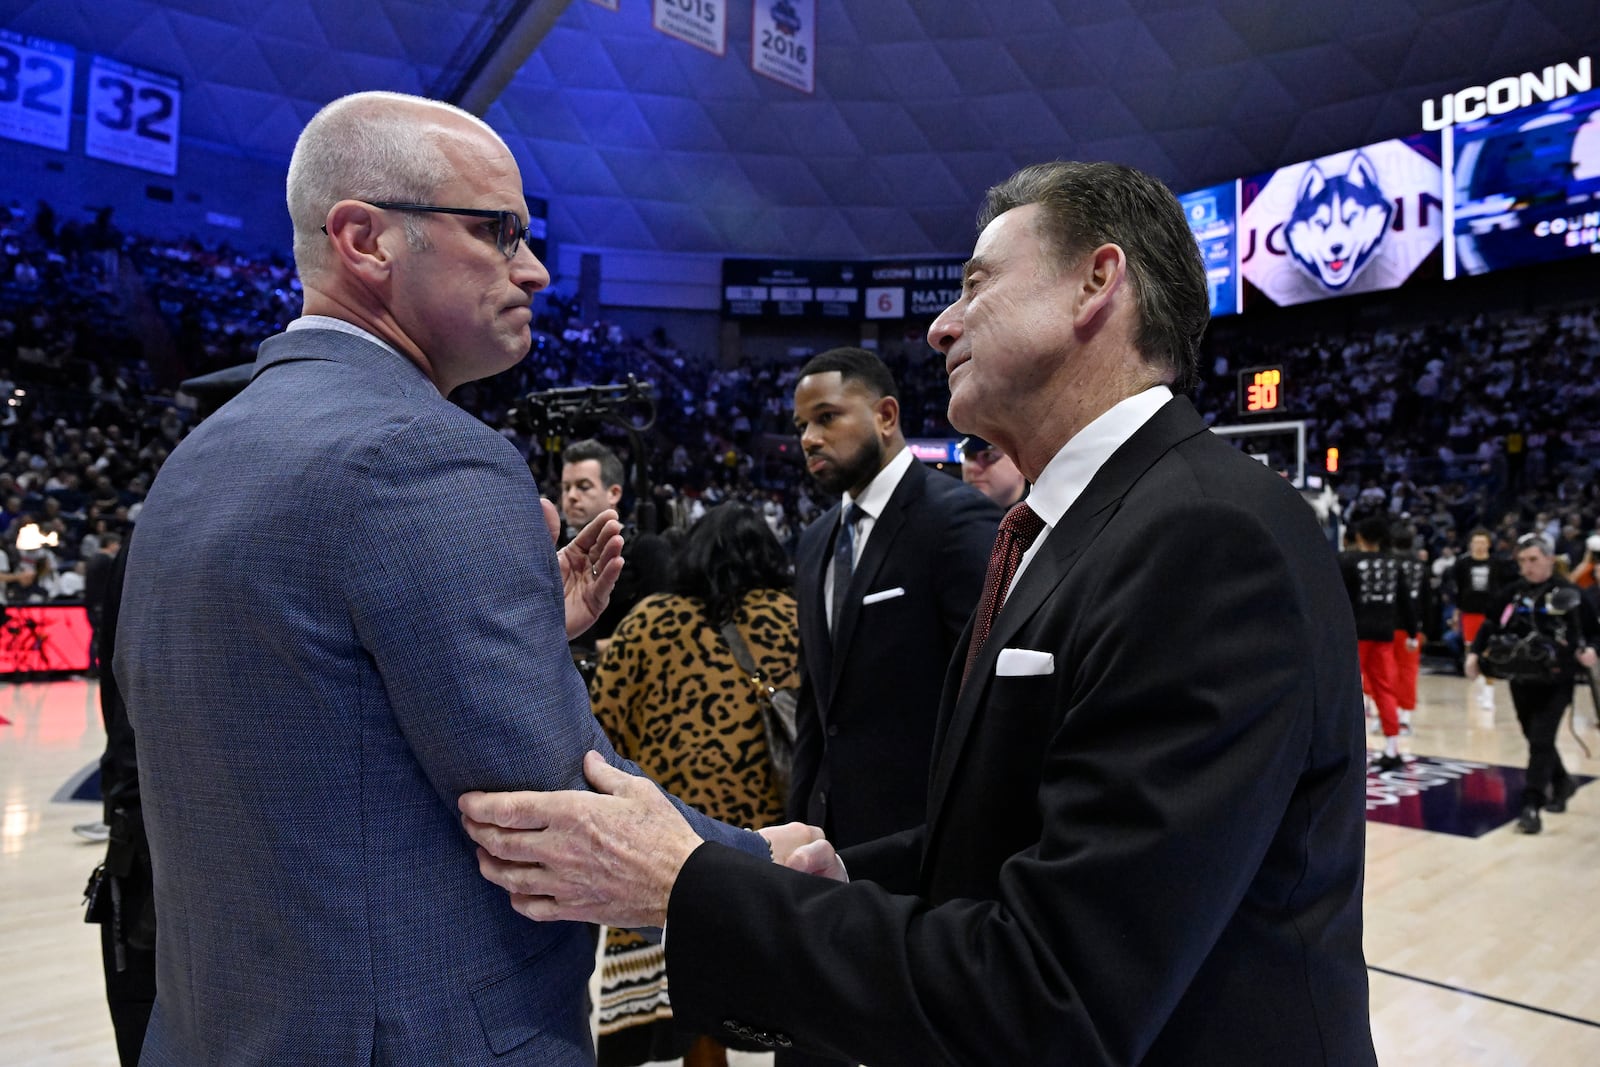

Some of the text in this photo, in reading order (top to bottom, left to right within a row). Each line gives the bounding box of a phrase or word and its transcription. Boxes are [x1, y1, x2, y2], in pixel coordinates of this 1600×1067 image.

[662, 0, 715, 23] 015
[762, 29, 807, 64] 2016
[1422, 56, 1592, 132] UCONN
[95, 76, 173, 144] 32
[878, 292, 892, 313] 6
[1248, 385, 1277, 411] 30
